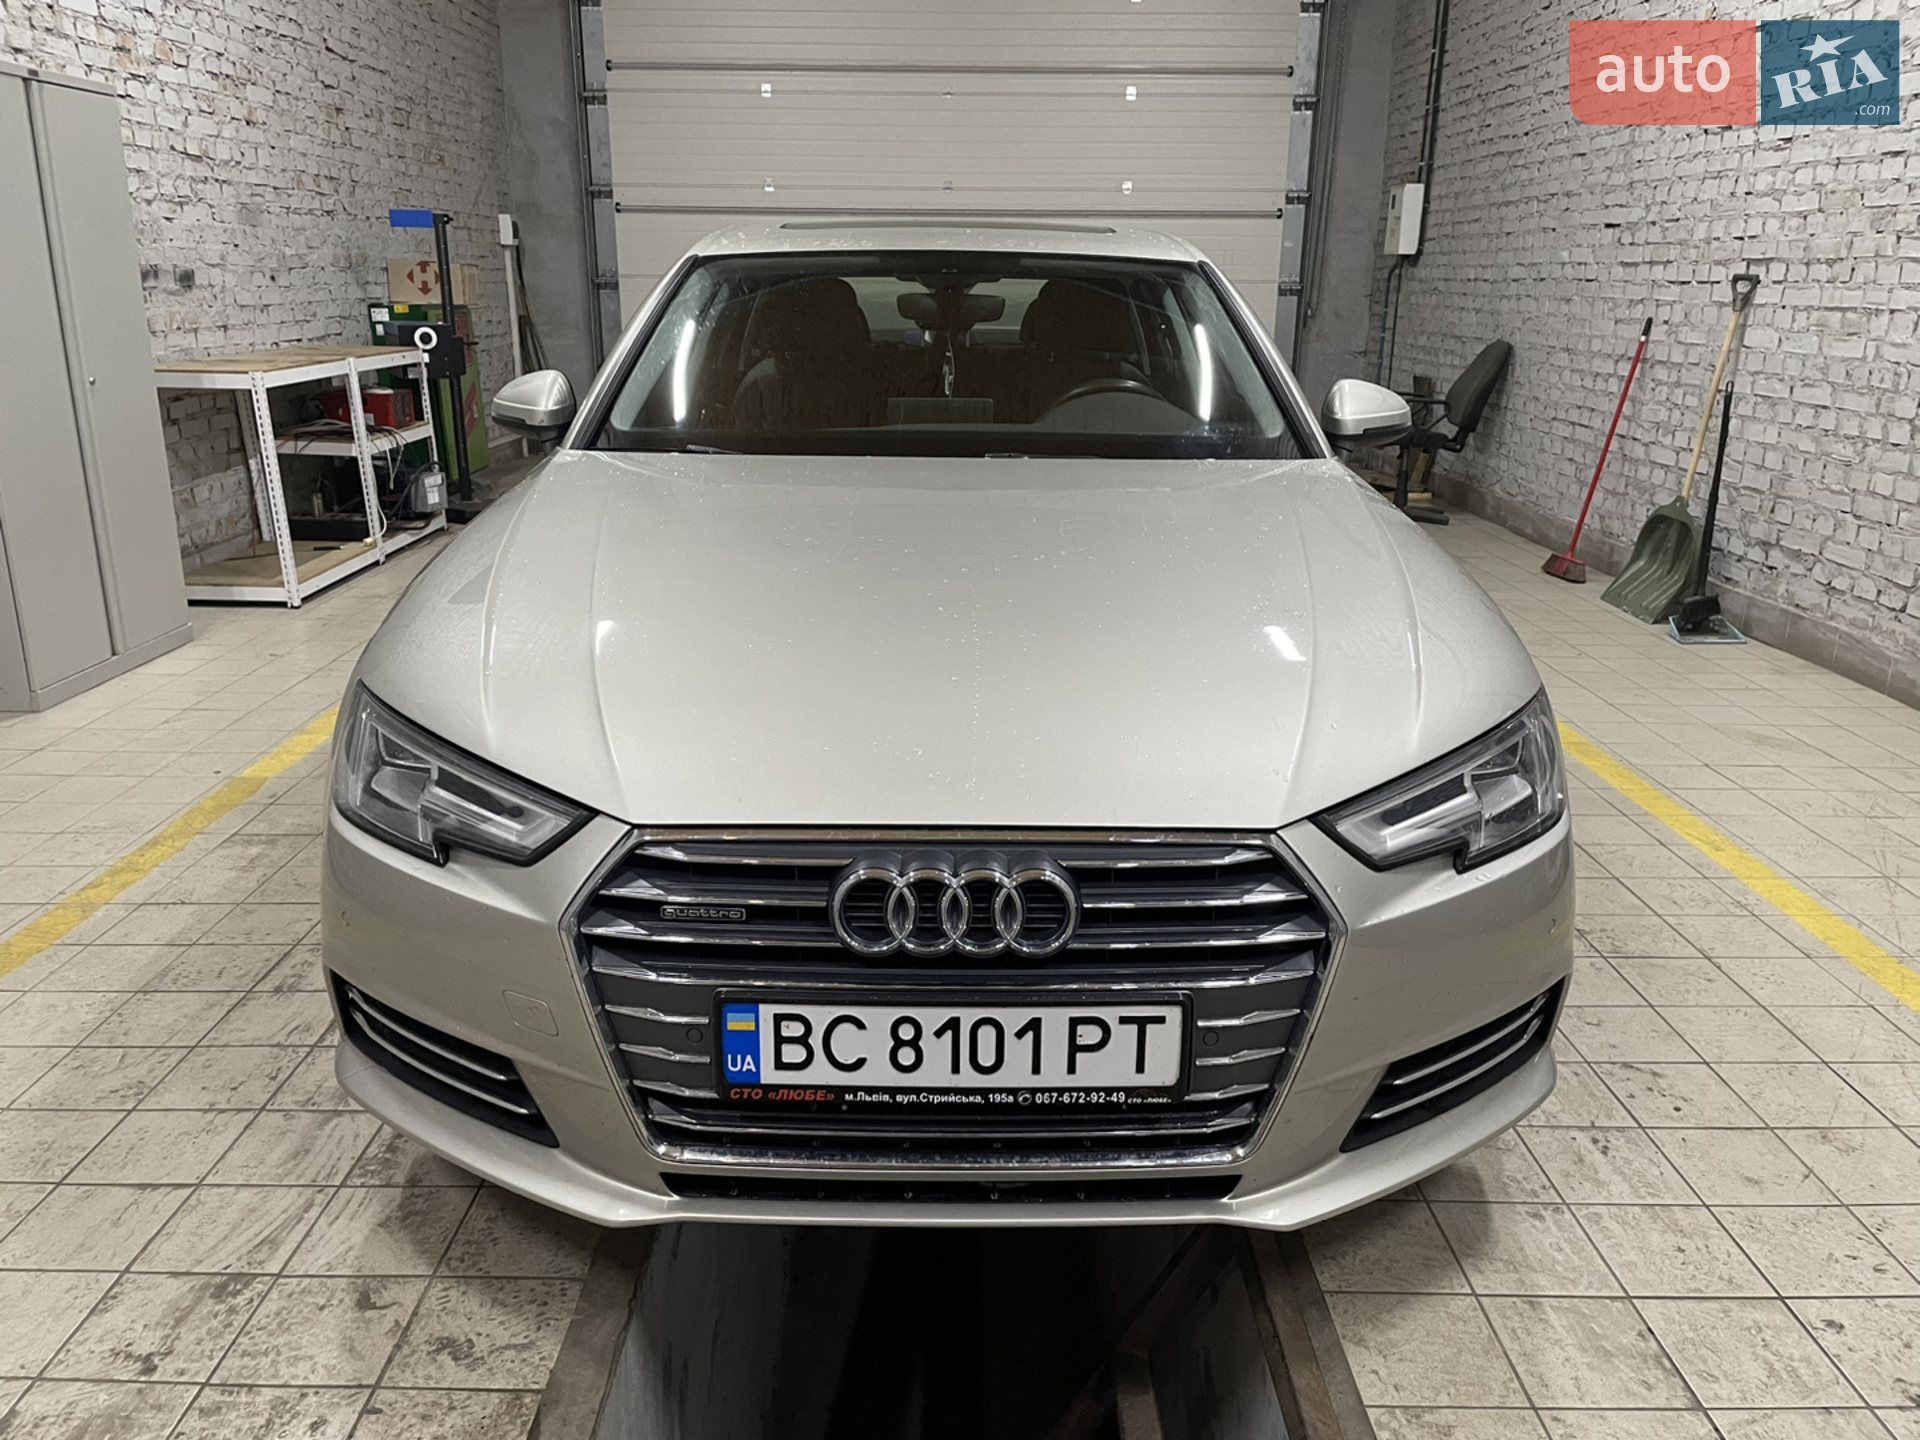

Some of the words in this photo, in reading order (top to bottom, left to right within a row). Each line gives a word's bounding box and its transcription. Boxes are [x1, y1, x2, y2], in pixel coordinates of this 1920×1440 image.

[664, 908, 741, 919] quattro
[773, 1012, 868, 1073] BC
[889, 1015, 1042, 1075] 8101
[1066, 1015, 1167, 1075] PT
[727, 1054, 756, 1072] UA
[730, 1087, 763, 1100] СТО
[1035, 1091, 1126, 1104] 067-672-92-49
